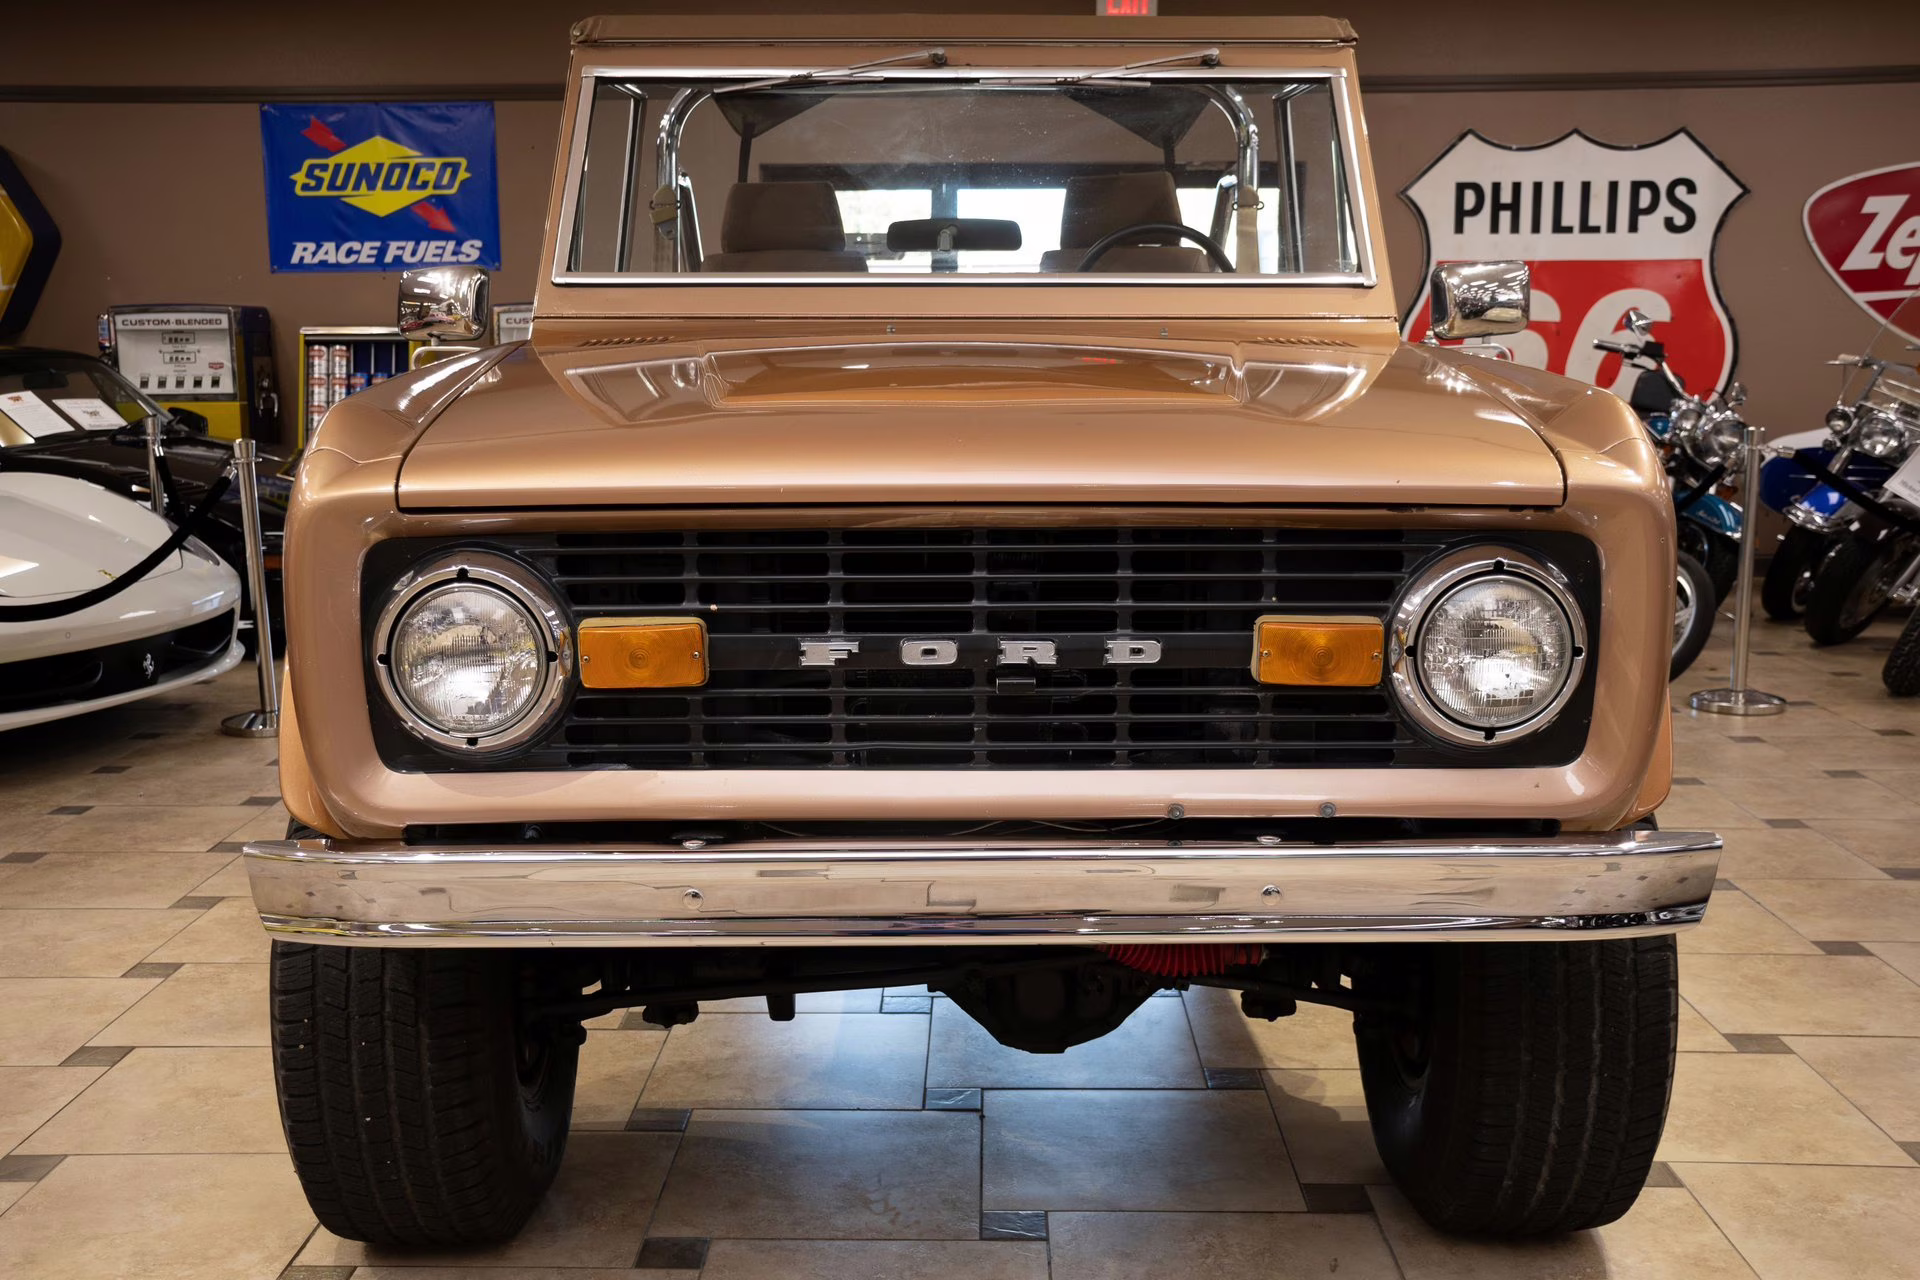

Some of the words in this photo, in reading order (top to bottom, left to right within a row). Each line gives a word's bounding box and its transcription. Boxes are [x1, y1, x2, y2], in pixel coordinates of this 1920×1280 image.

[300, 161, 463, 192] SUNOCO
[1453, 177, 1698, 234] PHILLIPS
[290, 241, 381, 264] RACE
[383, 239, 483, 264] FUELS
[1839, 194, 1920, 286] Ze
[505, 317, 532, 325] CUS
[799, 637, 1162, 666] FORD
